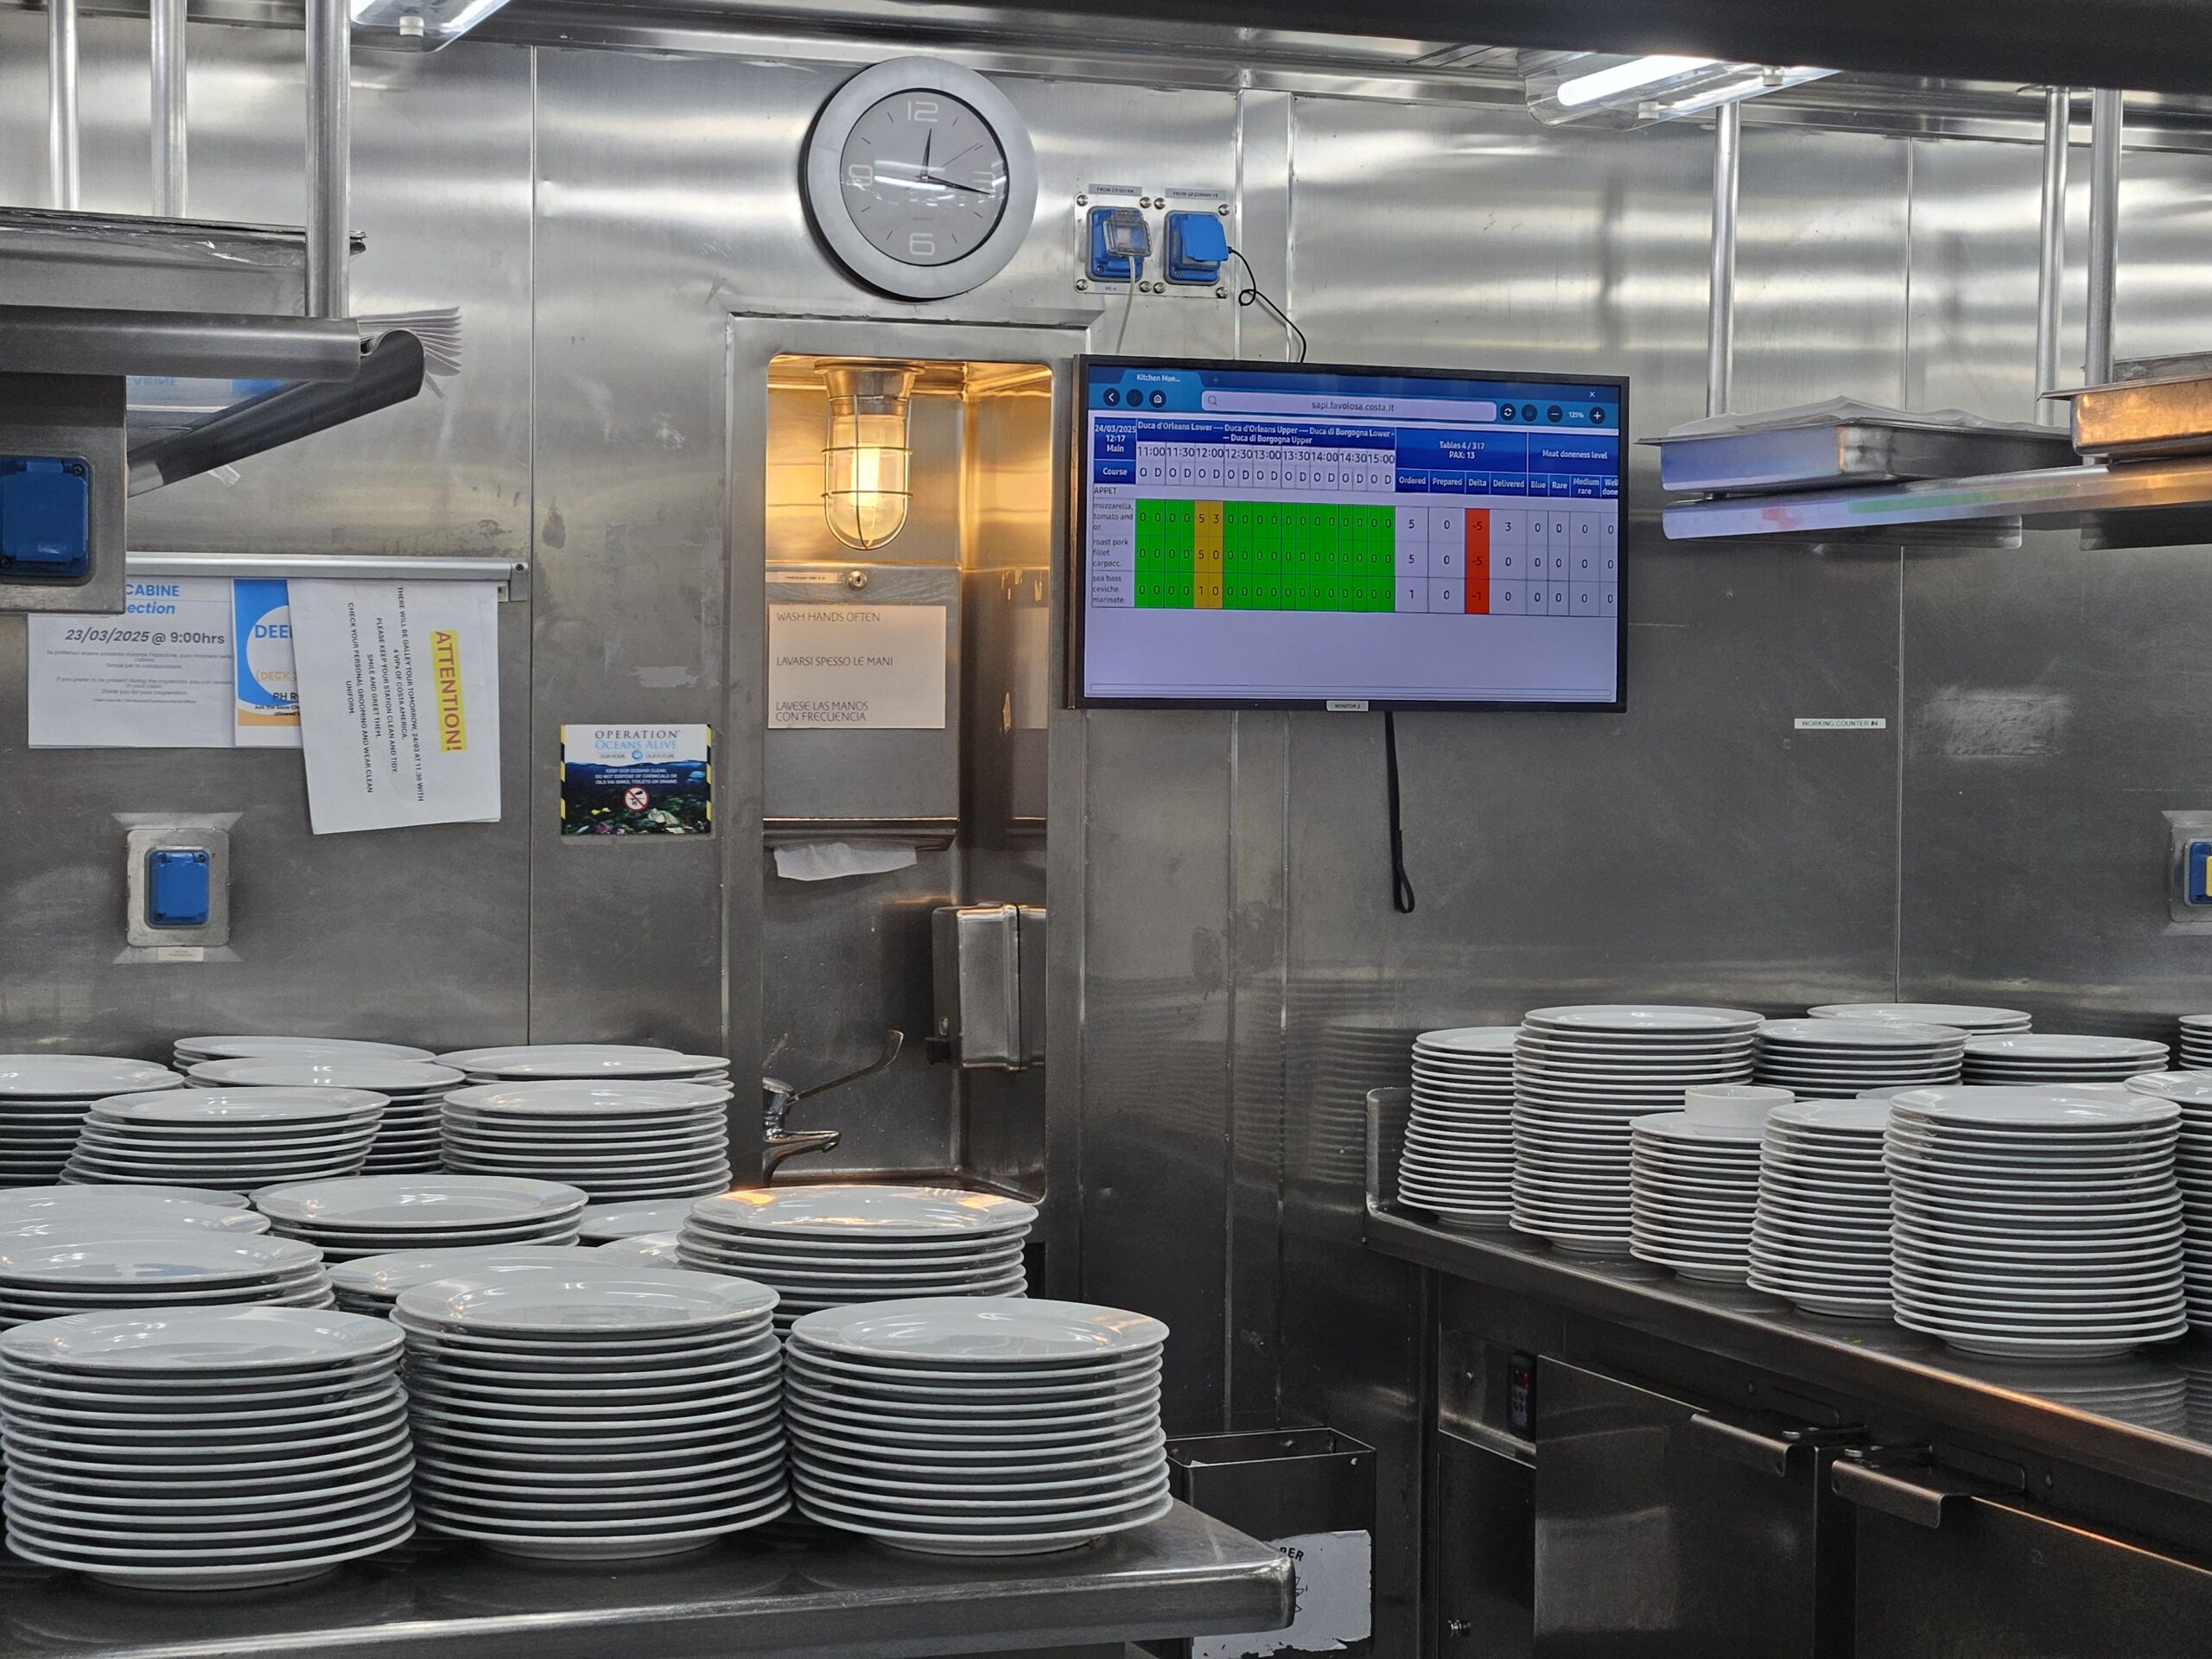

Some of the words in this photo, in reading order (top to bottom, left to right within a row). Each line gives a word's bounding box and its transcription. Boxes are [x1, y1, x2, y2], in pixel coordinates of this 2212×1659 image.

[907, 100, 938, 123] 12
[849, 164, 874, 187] 9
[909, 232, 936, 257] 6
[1136, 373, 1160, 382] Kitchen
[1312, 401, 1395, 412] sapi.favolosa.costa.it
[1095, 424, 1136, 434] 24/03/2025
[1156, 422, 1190, 431] d'Orleans
[1243, 425, 1276, 434] d'Orleans
[1276, 426, 1298, 435] Upper
[1336, 428, 1368, 438] Borgogna
[1230, 434, 1248, 442] Duca
[1257, 435, 1291, 445] Borgogna
[1291, 436, 1313, 445] Upper
[1440, 441, 1460, 449] Tables
[1106, 444, 1124, 453] Main
[1137, 447, 1166, 456] 11:00
[1166, 447, 1195, 457] 11:30
[1196, 448, 1224, 458] 12:00
[1225, 448, 1252, 459] 12:30
[1254, 449, 1281, 460] 13:00
[1283, 450, 1310, 461] 13:30
[1312, 451, 1338, 461] 14:00
[1339, 452, 1367, 463] 14:30
[1369, 453, 1395, 464] 15:00
[1542, 449, 1559, 458] Meat
[1560, 450, 1590, 459] doneness
[1591, 451, 1607, 460] level
[1103, 467, 1128, 476] Course
[1399, 476, 1426, 485] Ordered
[1433, 477, 1463, 486] Prepared
[1493, 480, 1525, 488] Delivered
[1530, 480, 1546, 489] Blue
[1408, 519, 1415, 529] 5
[1444, 520, 1451, 530] 0
[1472, 521, 1483, 531] -5
[1505, 522, 1512, 531] 3
[1408, 554, 1415, 563] 5
[1444, 555, 1450, 564] 0
[1472, 556, 1483, 566] -5
[1505, 556, 1512, 567] 0
[126, 584, 180, 597] CABINE
[397, 587, 405, 608] THERE
[126, 601, 176, 614] ection
[347, 602, 356, 628] CHECK
[776, 612, 805, 622] WASH
[808, 612, 844, 622] HANDS
[846, 612, 880, 622] OFTEN
[65, 627, 150, 644] 23/03/2025
[152, 632, 166, 645] @
[170, 632, 226, 645] 9:00hrs
[350, 628, 359, 649] YOUR
[376, 617, 385, 644] PLEASE
[402, 629, 409, 639] BE
[403, 639, 413, 666] GALLEY
[776, 656, 813, 666] LAVARSI
[816, 656, 851, 666] SPESSO
[853, 657, 865, 666] LE
[867, 656, 893, 666] MANI
[353, 649, 364, 688] PERSONAL
[366, 653, 375, 675] SMILE
[395, 670, 403, 680] OF
[404, 666, 414, 689] TOUR
[273, 692, 288, 701] PH
[346, 680, 355, 715] UNIFORM.
[396, 681, 404, 706] COSTA
[435, 631, 462, 751] ATTENTION!
[358, 688, 368, 729] GROOMING
[371, 692, 380, 716] GREET
[384, 685, 392, 715] STATION
[776, 701, 810, 711] LAVESE
[812, 701, 830, 711] LAS
[831, 701, 869, 711] MANOS
[407, 689, 419, 732] TOMORROW,
[775, 711, 799, 721] CON
[802, 711, 867, 721] FRECUENCIA
[373, 716, 382, 739] THEM.
[386, 715, 395, 739] CLEAN
[397, 706, 408, 741] AMERICA.
[412, 732, 421, 752] 24/03
[594, 729, 677, 740] OPERATION
[594, 740, 642, 750] OCEANS
[645, 740, 677, 750] ALIVE
[363, 746, 372, 768] WEAR
[414, 753, 422, 762] AT
[365, 768, 373, 793] CLEAN
